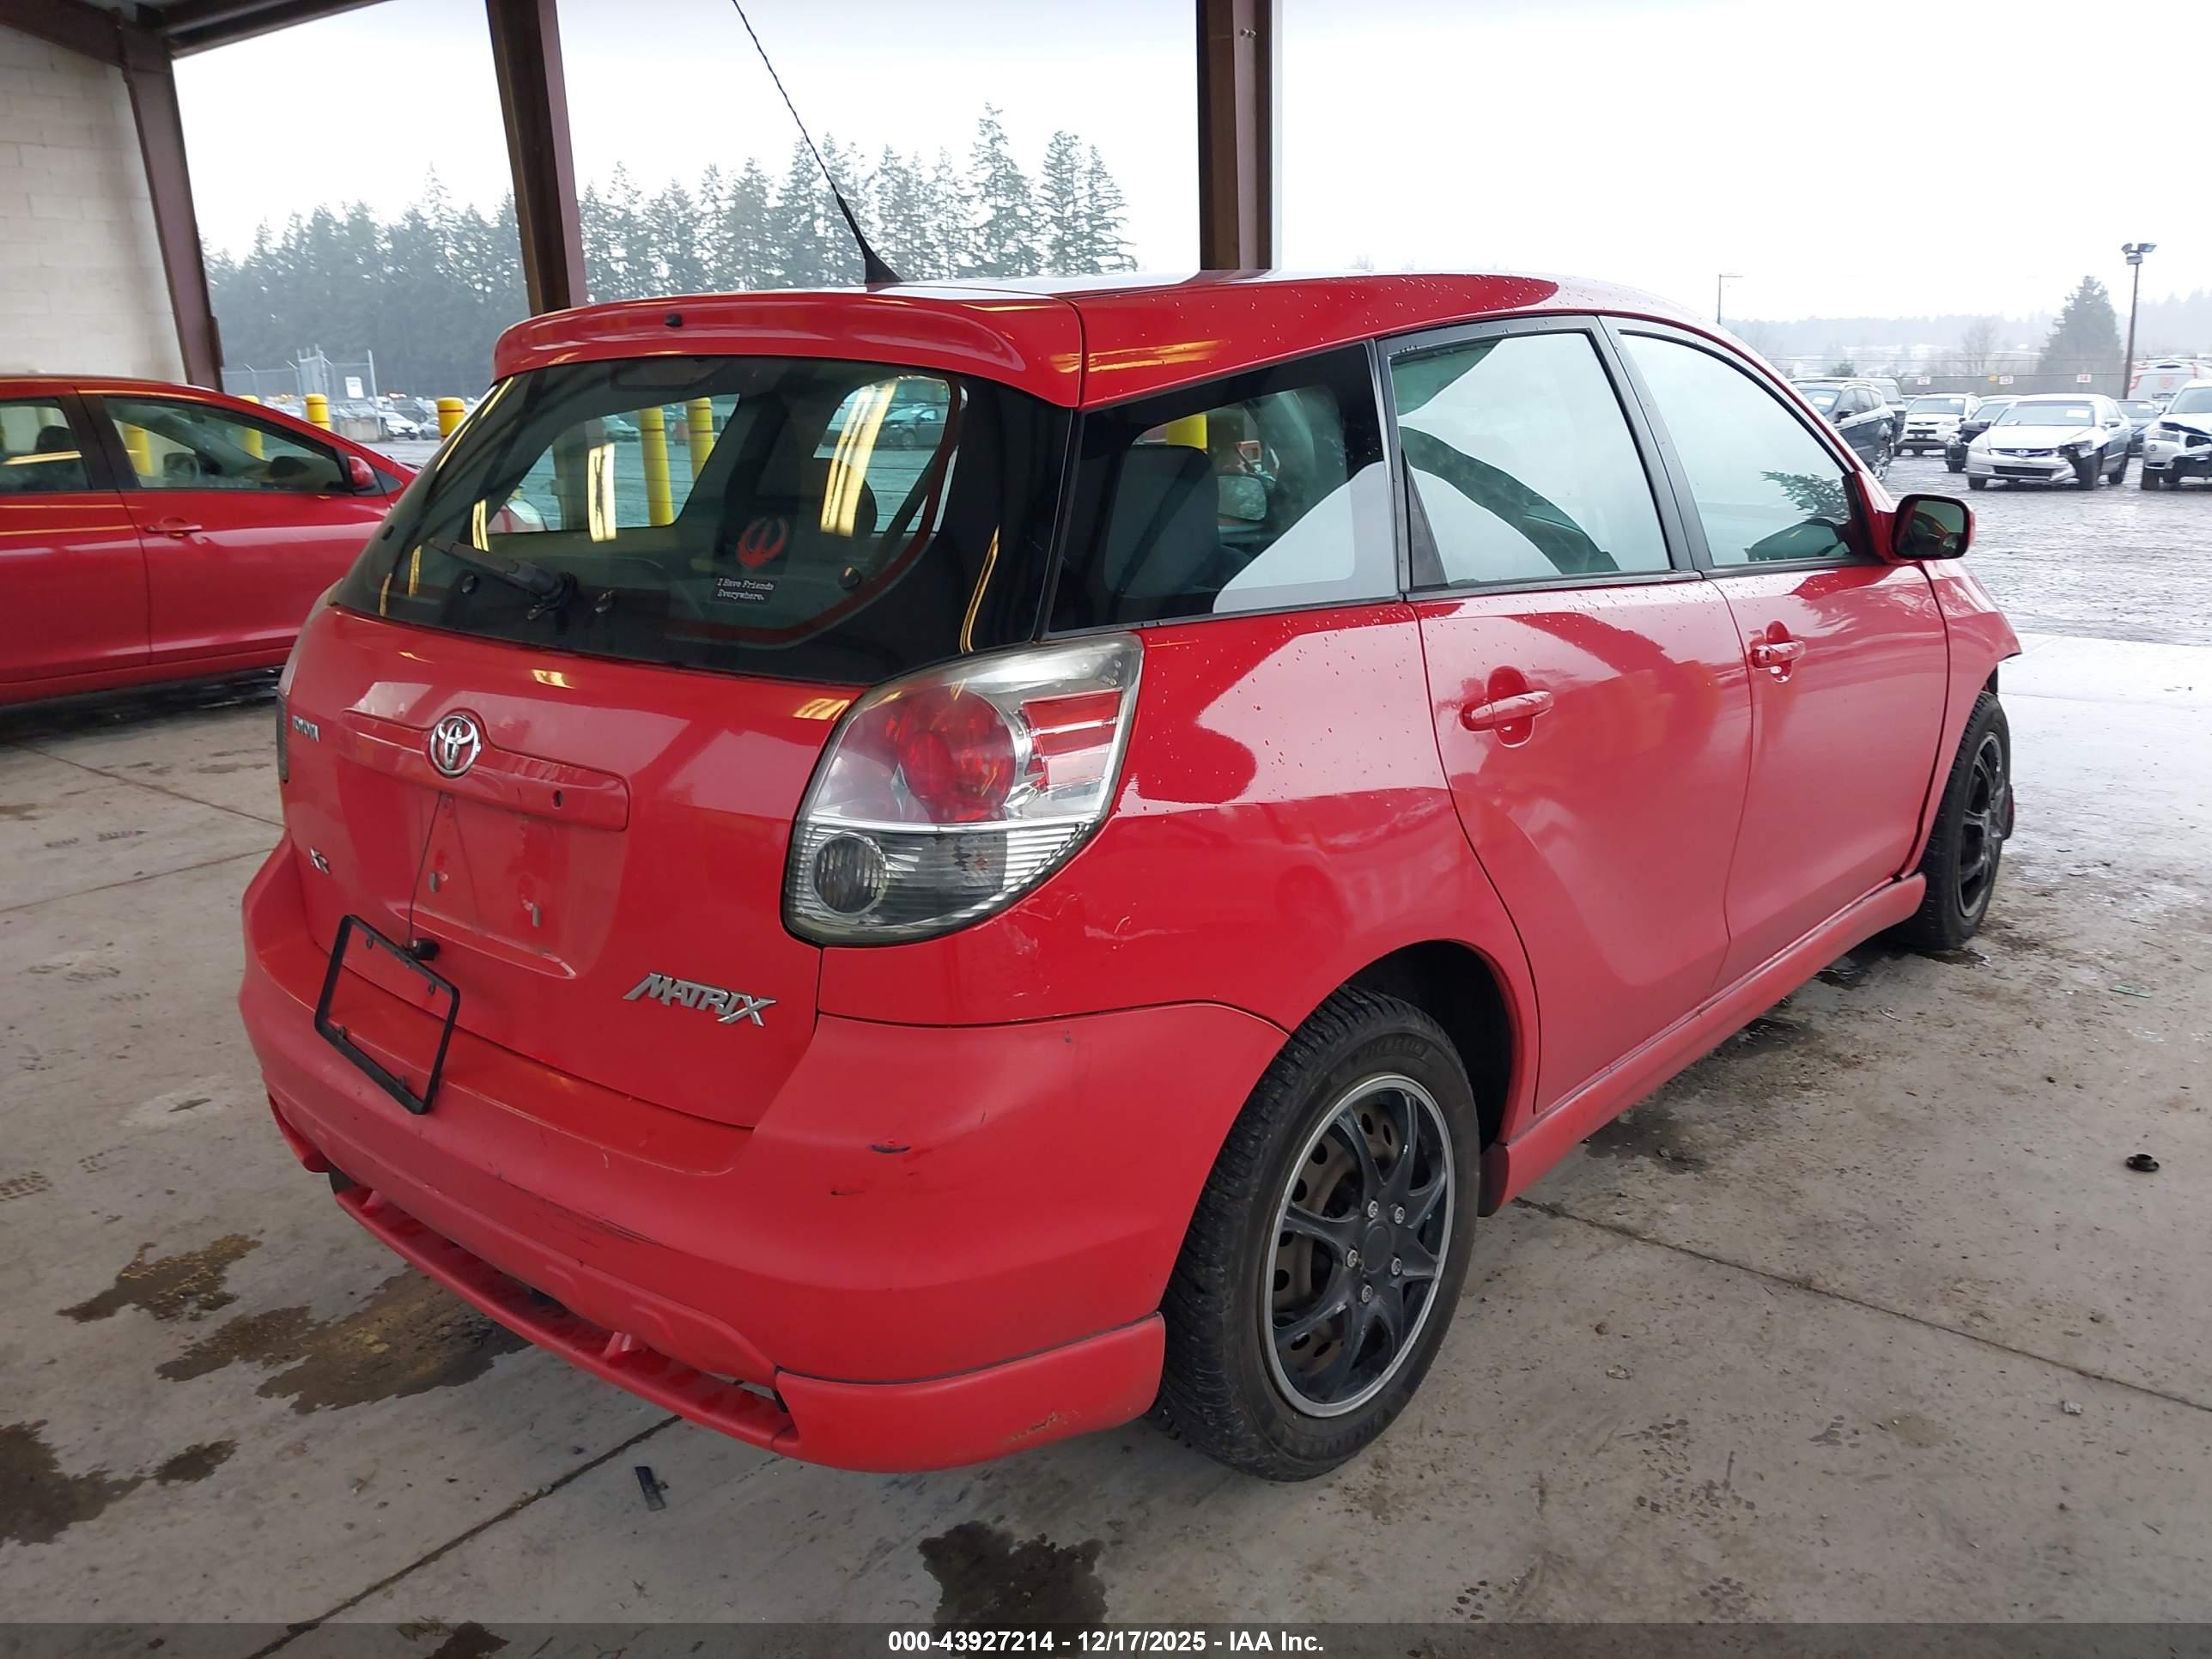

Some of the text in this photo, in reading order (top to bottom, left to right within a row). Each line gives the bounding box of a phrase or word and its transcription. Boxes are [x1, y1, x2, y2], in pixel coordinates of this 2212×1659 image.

[717, 577, 775, 591] I Have Friends
[717, 588, 765, 600] Everywhere.
[623, 972, 777, 1027] MATRIX
